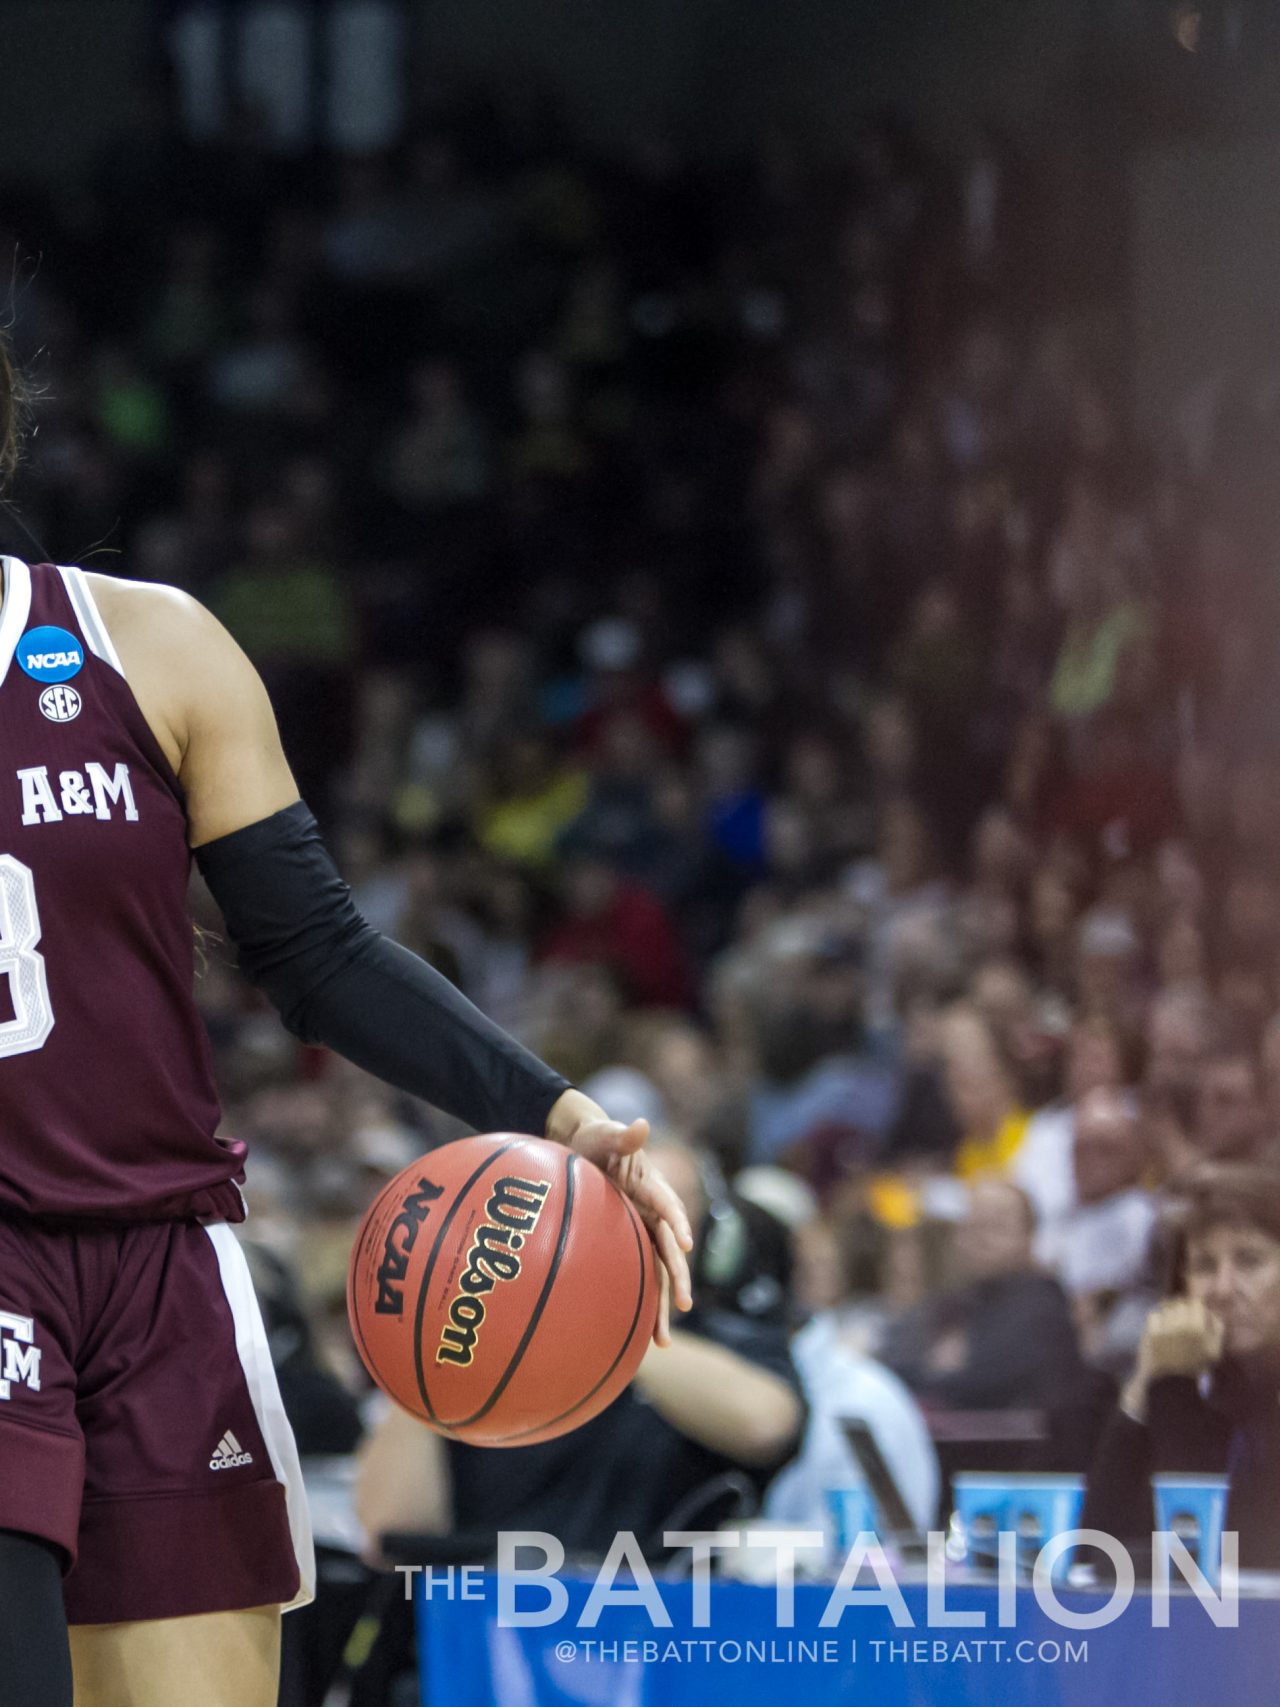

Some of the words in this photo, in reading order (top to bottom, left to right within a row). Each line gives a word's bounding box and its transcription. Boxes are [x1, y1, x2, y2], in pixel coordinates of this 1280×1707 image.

[27, 651, 81, 669] NCAA
[42, 687, 78, 720] SEC
[17, 762, 139, 827] A&M
[375, 1177, 445, 1315] NCAA
[436, 1175, 552, 1367] Wilson
[209, 1452, 253, 1470] adidas
